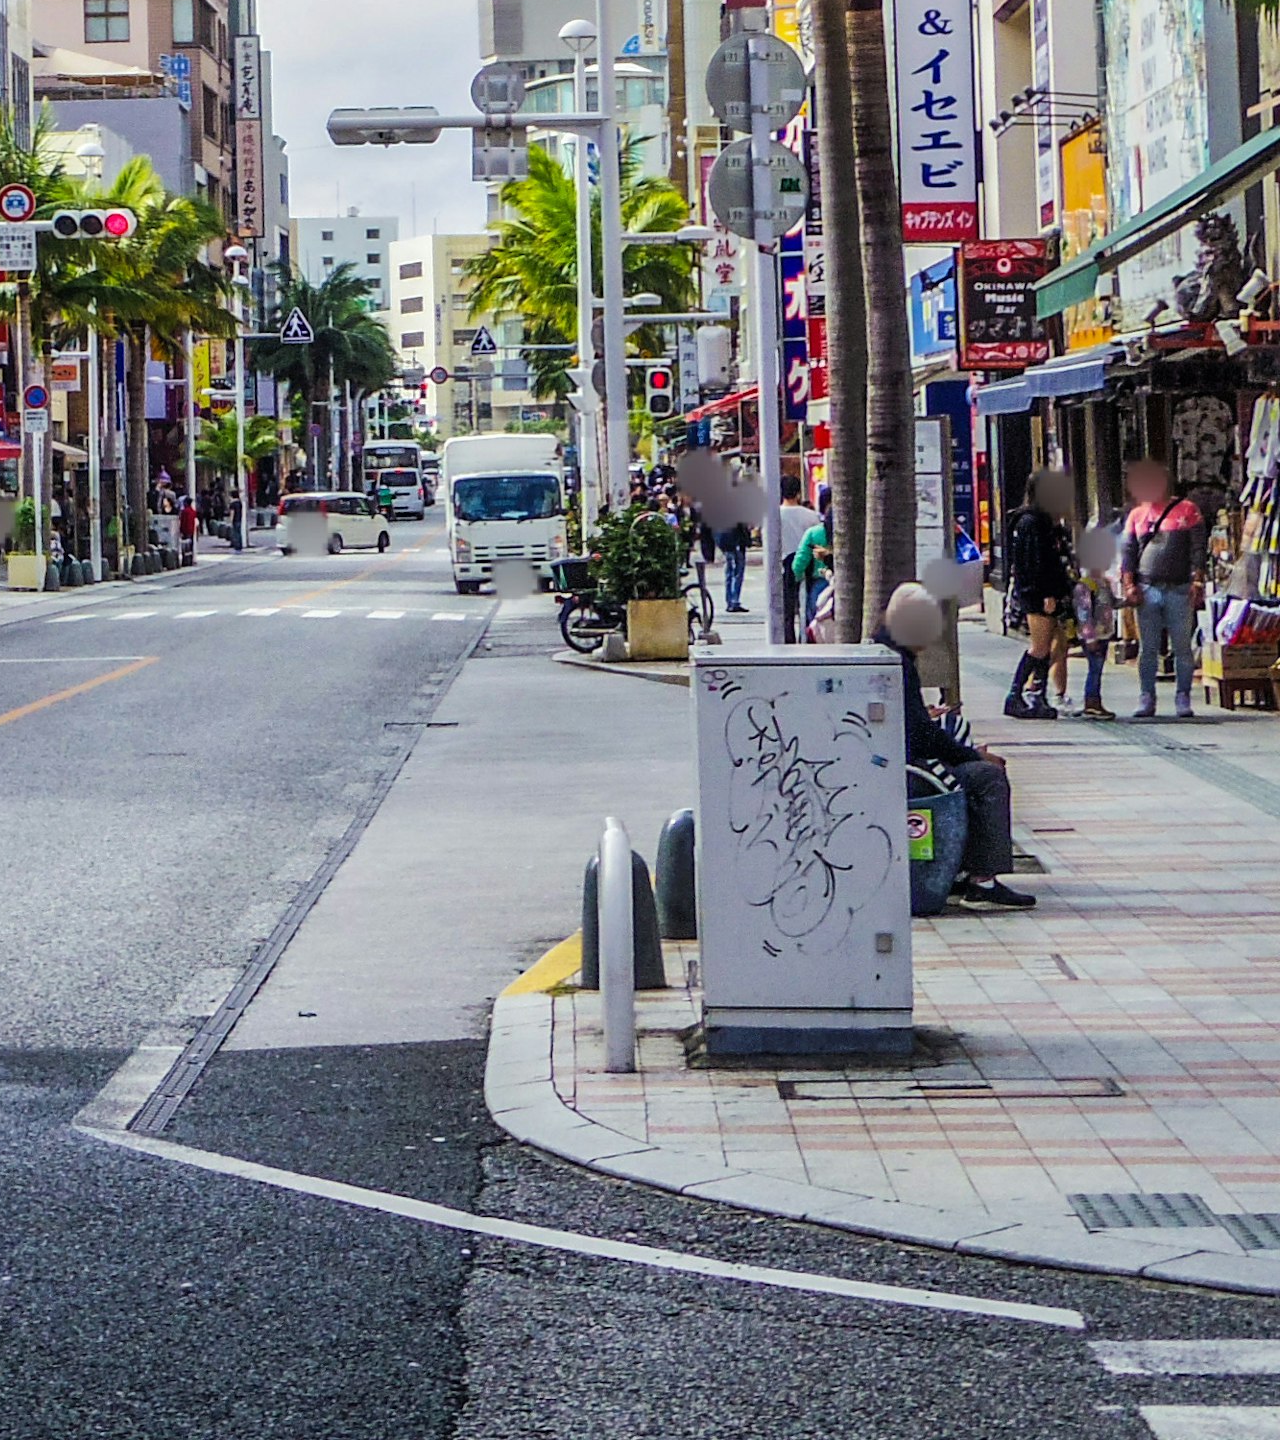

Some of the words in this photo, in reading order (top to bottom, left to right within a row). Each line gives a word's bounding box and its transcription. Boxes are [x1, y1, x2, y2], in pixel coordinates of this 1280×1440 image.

[905, 210, 955, 229] キャプテンズ
[956, 210, 974, 228] イン
[984, 293, 1025, 303] Music
[995, 304, 1017, 314] Bar
